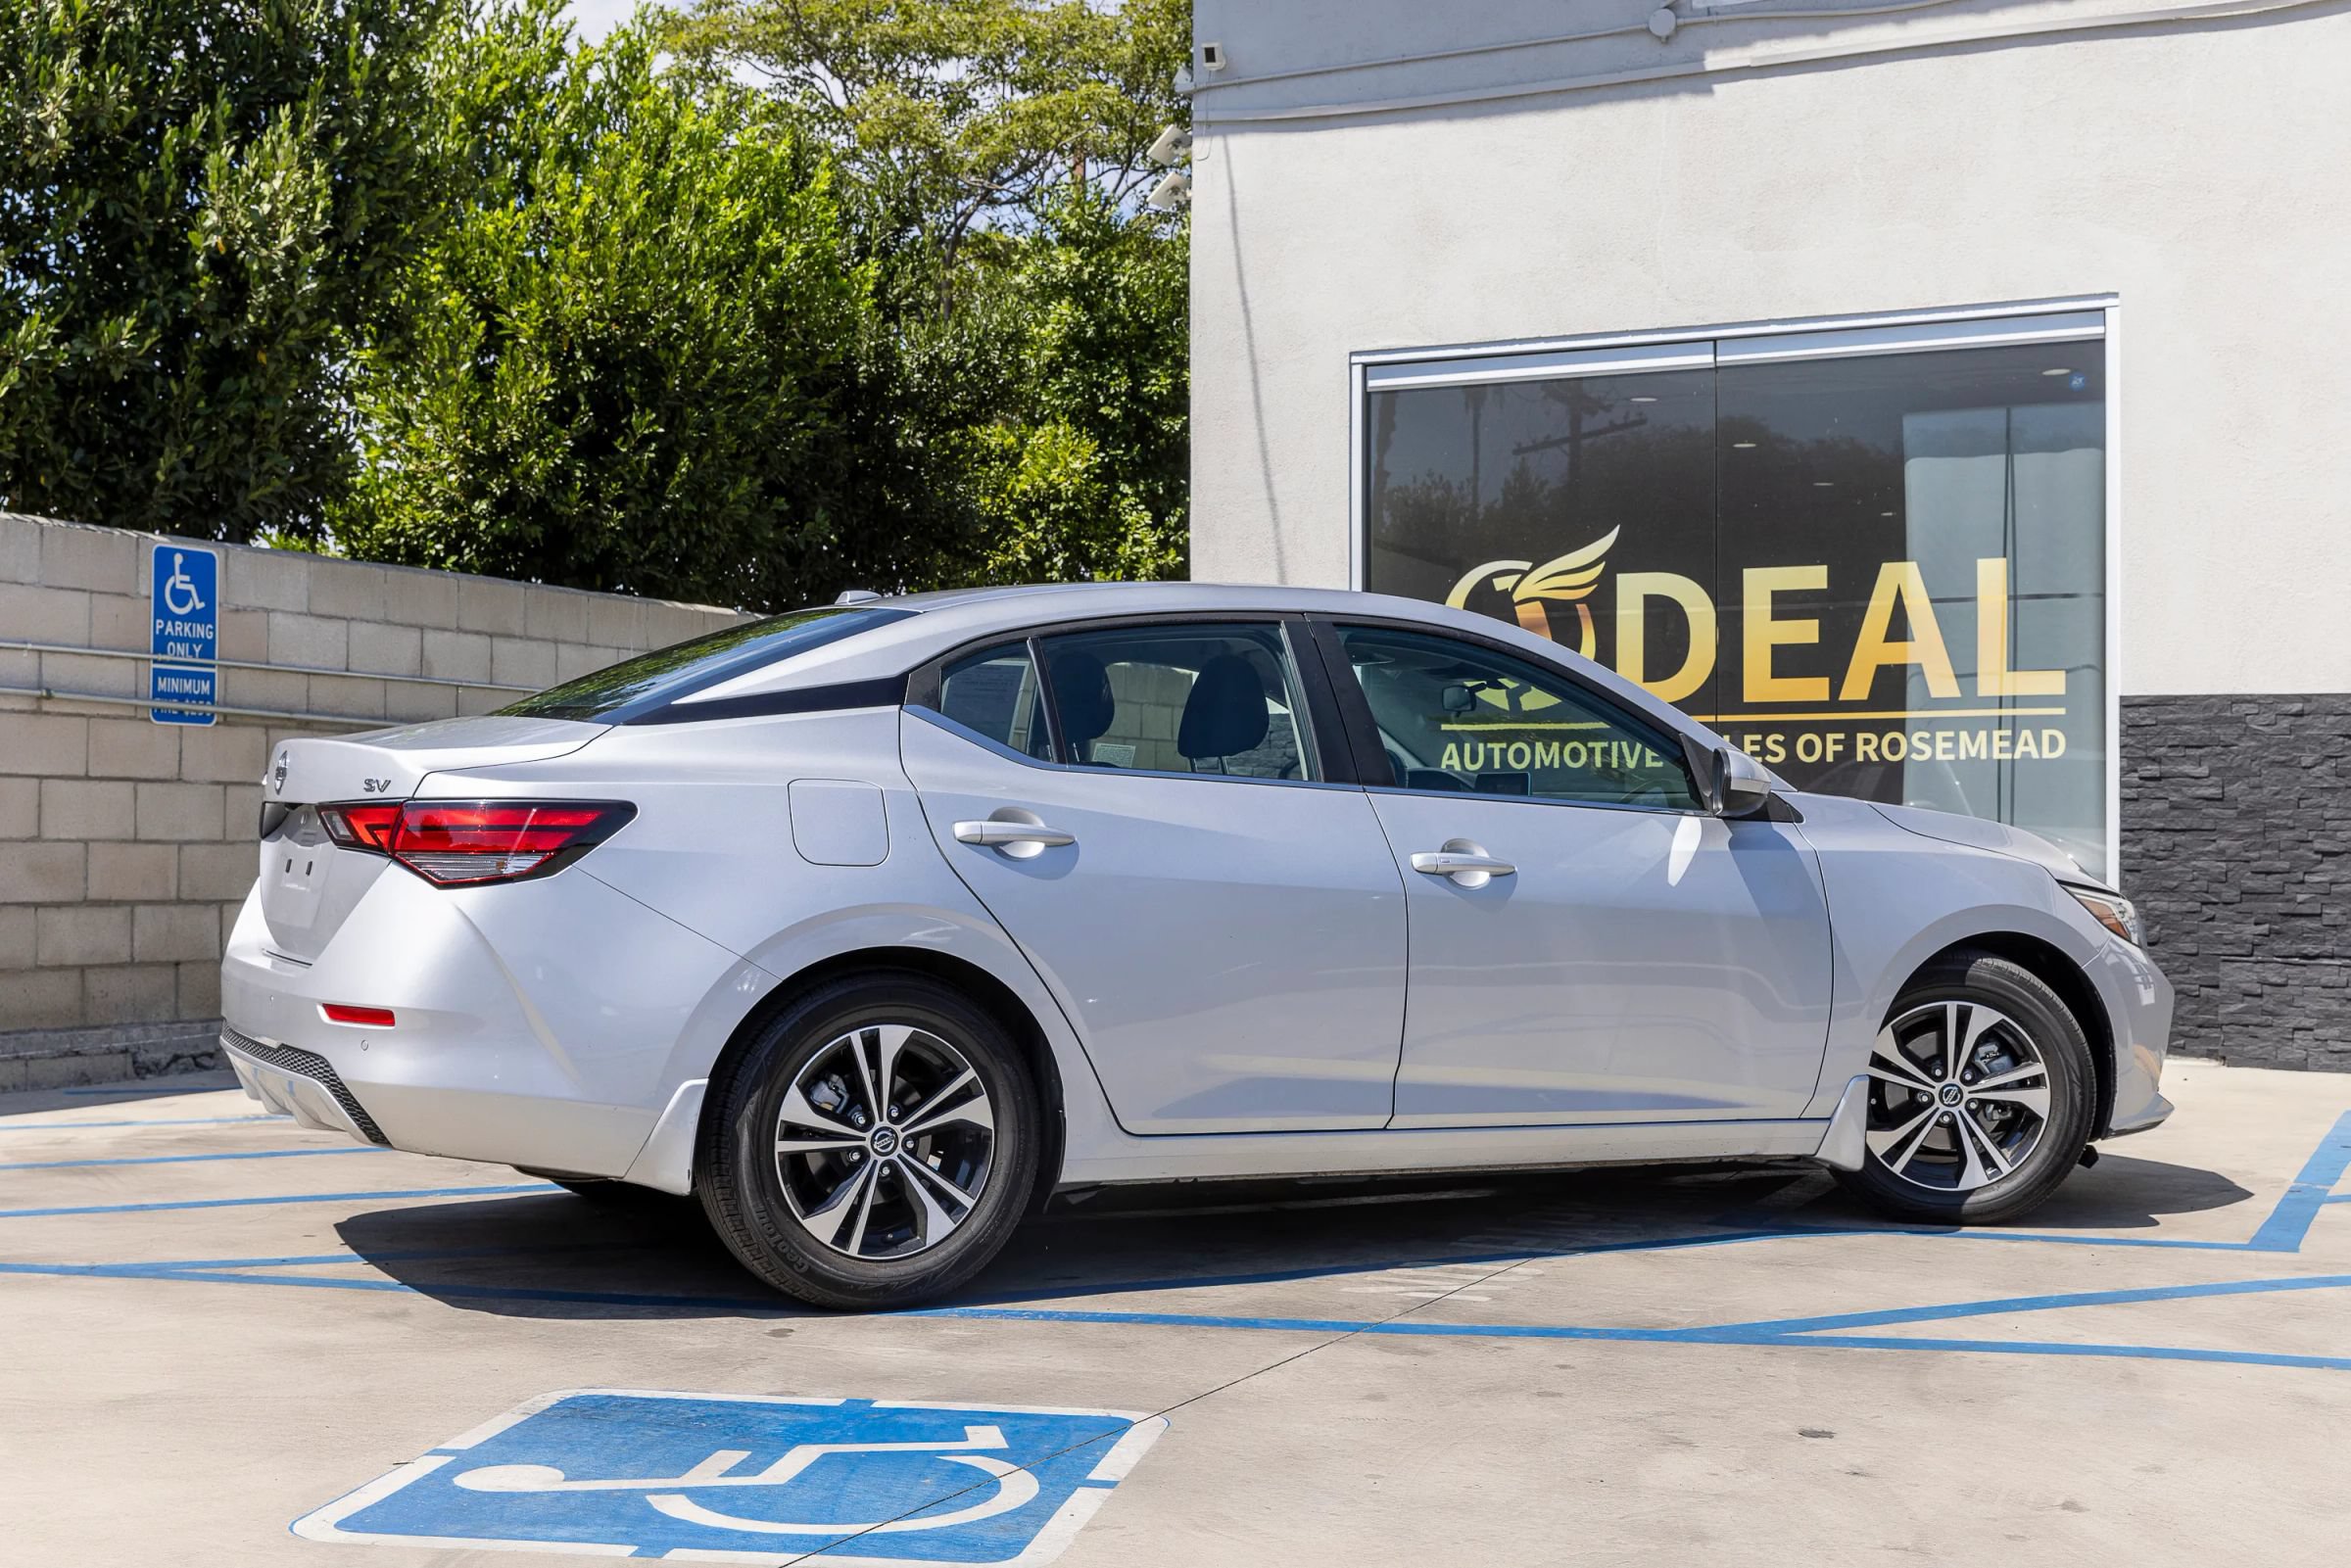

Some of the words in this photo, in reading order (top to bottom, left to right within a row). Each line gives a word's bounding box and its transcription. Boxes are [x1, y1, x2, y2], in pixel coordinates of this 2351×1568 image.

[156, 619, 215, 640] PARKING
[167, 641, 204, 659] ONLY
[158, 677, 211, 695] MINIMUM
[1440, 740, 1664, 770] AUTOMOTIVE
[1796, 733, 1847, 764] OF
[1855, 729, 2067, 763] ROSEMEAD
[363, 778, 392, 793] SV
